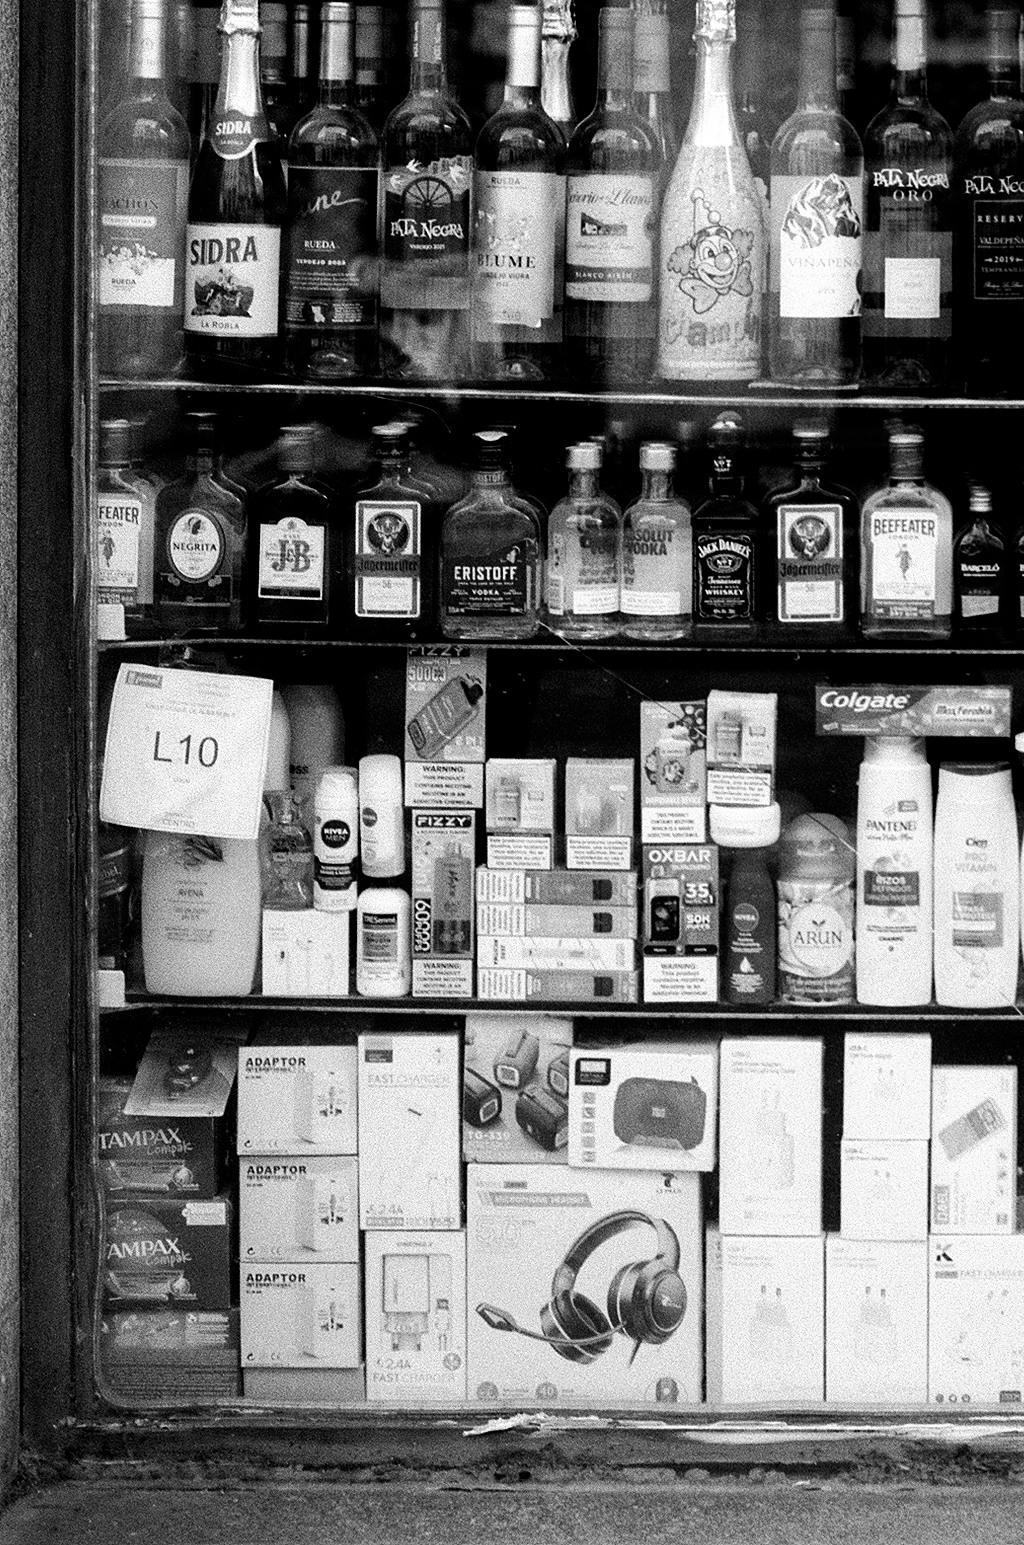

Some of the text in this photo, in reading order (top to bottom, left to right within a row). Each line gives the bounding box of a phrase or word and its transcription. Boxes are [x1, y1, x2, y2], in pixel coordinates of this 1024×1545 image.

[215, 121, 252, 135] SIDRA
[492, 176, 520, 185] RUEDA
[874, 168, 950, 189] PATA NEGRA
[965, 175, 995, 194] PATA
[892, 190, 933, 202] ORO
[390, 218, 464, 238] PATA NEGRA
[190, 236, 259, 266] SIDRA
[304, 240, 336, 249] RUEDA
[478, 255, 536, 269] BLUME
[111, 278, 137, 286] RUEDA
[200, 322, 240, 330] LA ROBLA
[874, 518, 935, 537] BEEFEATER
[172, 542, 217, 552] NEGRITA
[698, 539, 751, 557] JACK DANIEL'S
[272, 539, 312, 573] J&B
[359, 558, 418, 574] Jägermeister
[780, 563, 839, 577] Jägermeister
[960, 564, 1000, 573] BARCELÓ
[454, 566, 516, 582] ERISTOFF
[820, 690, 910, 712] Colgate
[153, 730, 219, 768] L10
[416, 816, 469, 828] FIZZY
[866, 819, 916, 831] PANTENE
[323, 828, 349, 836] NIVEA
[324, 833, 346, 841] MEN
[966, 837, 988, 848] Cien
[649, 849, 711, 863] OXBAR
[685, 882, 710, 898] 35
[794, 928, 843, 945] ARUN
[245, 1056, 306, 1068] ADAPTOR
[99, 1128, 182, 1150] TAMPAX
[247, 1164, 307, 1175] ADAPTOR
[246, 1272, 306, 1284] ADAPTOR
